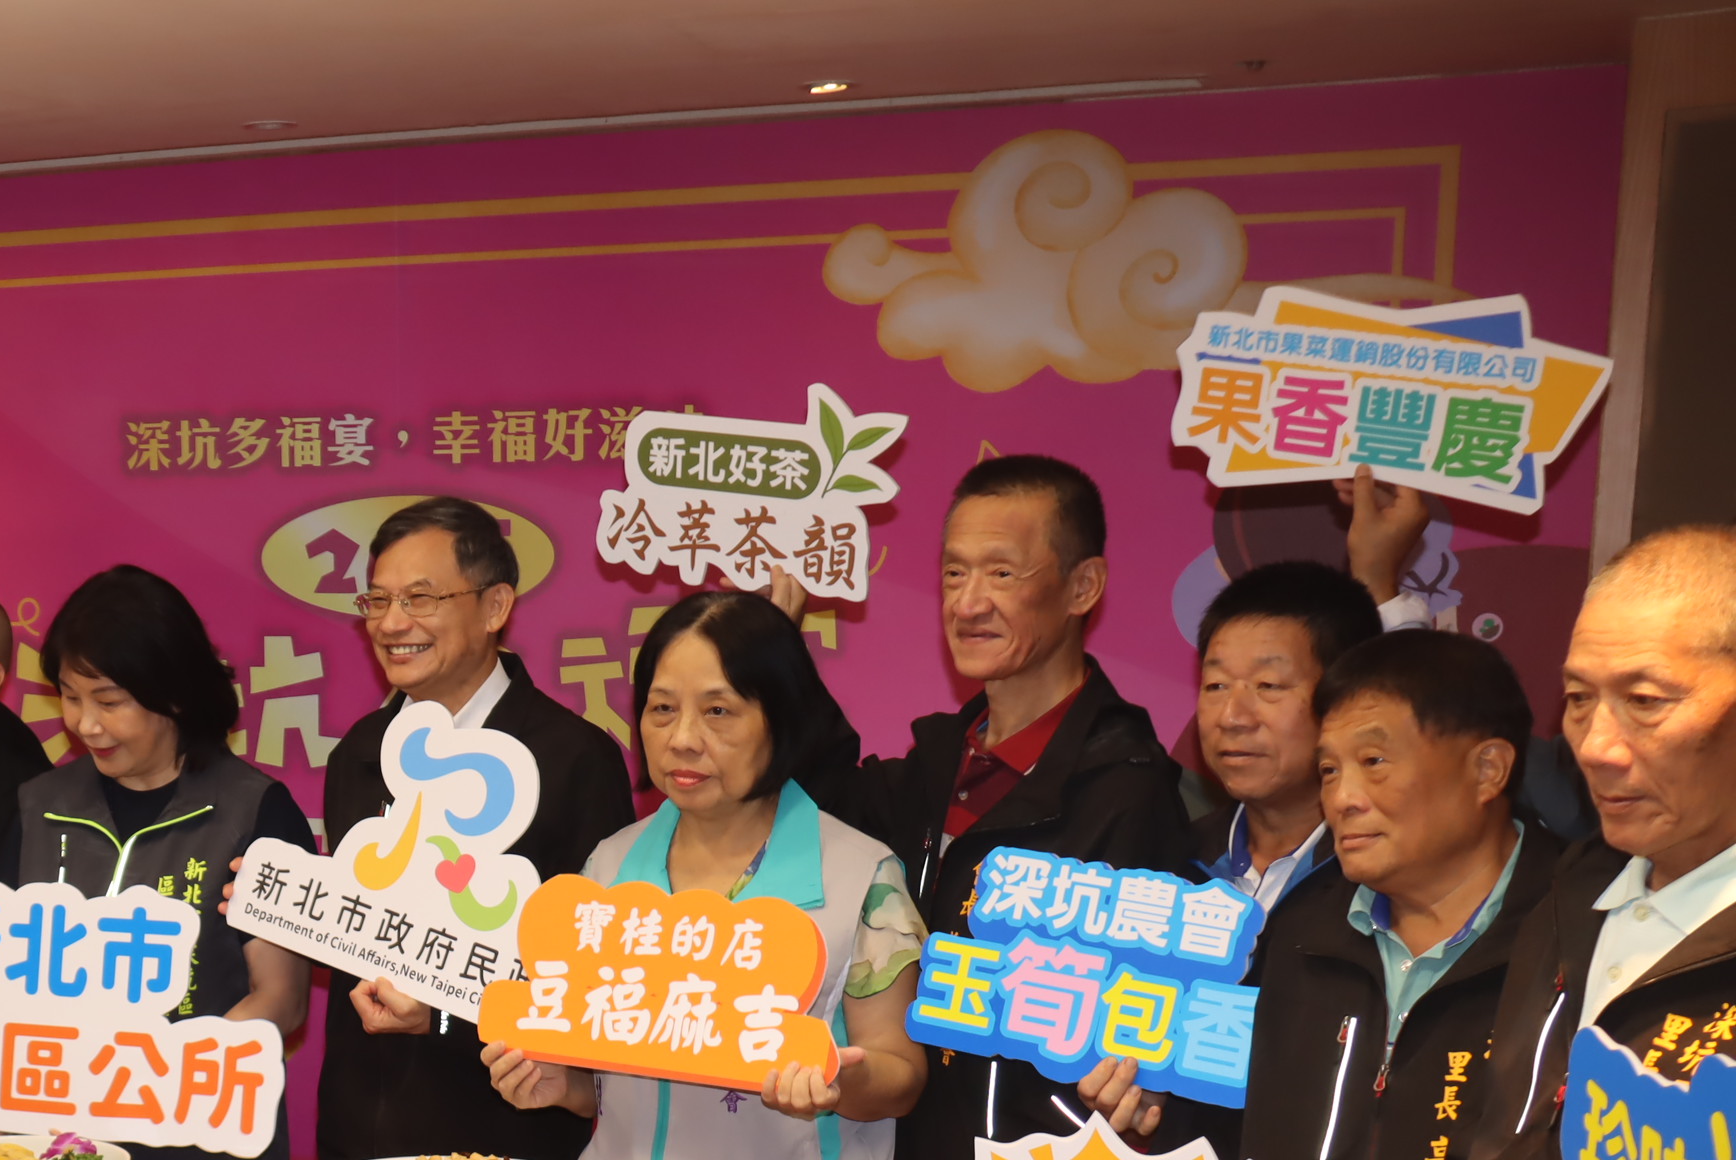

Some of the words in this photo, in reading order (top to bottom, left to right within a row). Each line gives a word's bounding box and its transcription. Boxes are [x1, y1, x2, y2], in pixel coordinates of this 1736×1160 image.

[1208, 324, 1538, 384] 新北市果菜運銷股份有限公司
[125, 404, 704, 472] 深坑多福宴，幸福好滋
[648, 436, 810, 491] 新北好茶
[1187, 366, 1526, 485] 果香豐慶
[606, 498, 857, 591] 冷萃茶韻
[244, 902, 314, 941] Department
[315, 931, 331, 945] of
[330, 936, 357, 957] Civil
[430, 972, 468, 1002] Taipei
[981, 854, 1247, 958] 深坑農會
[516, 960, 799, 1063] 豆福麻吉
[918, 937, 1260, 1080] 玉筍包香
[1434, 1051, 1472, 1121] 里長
